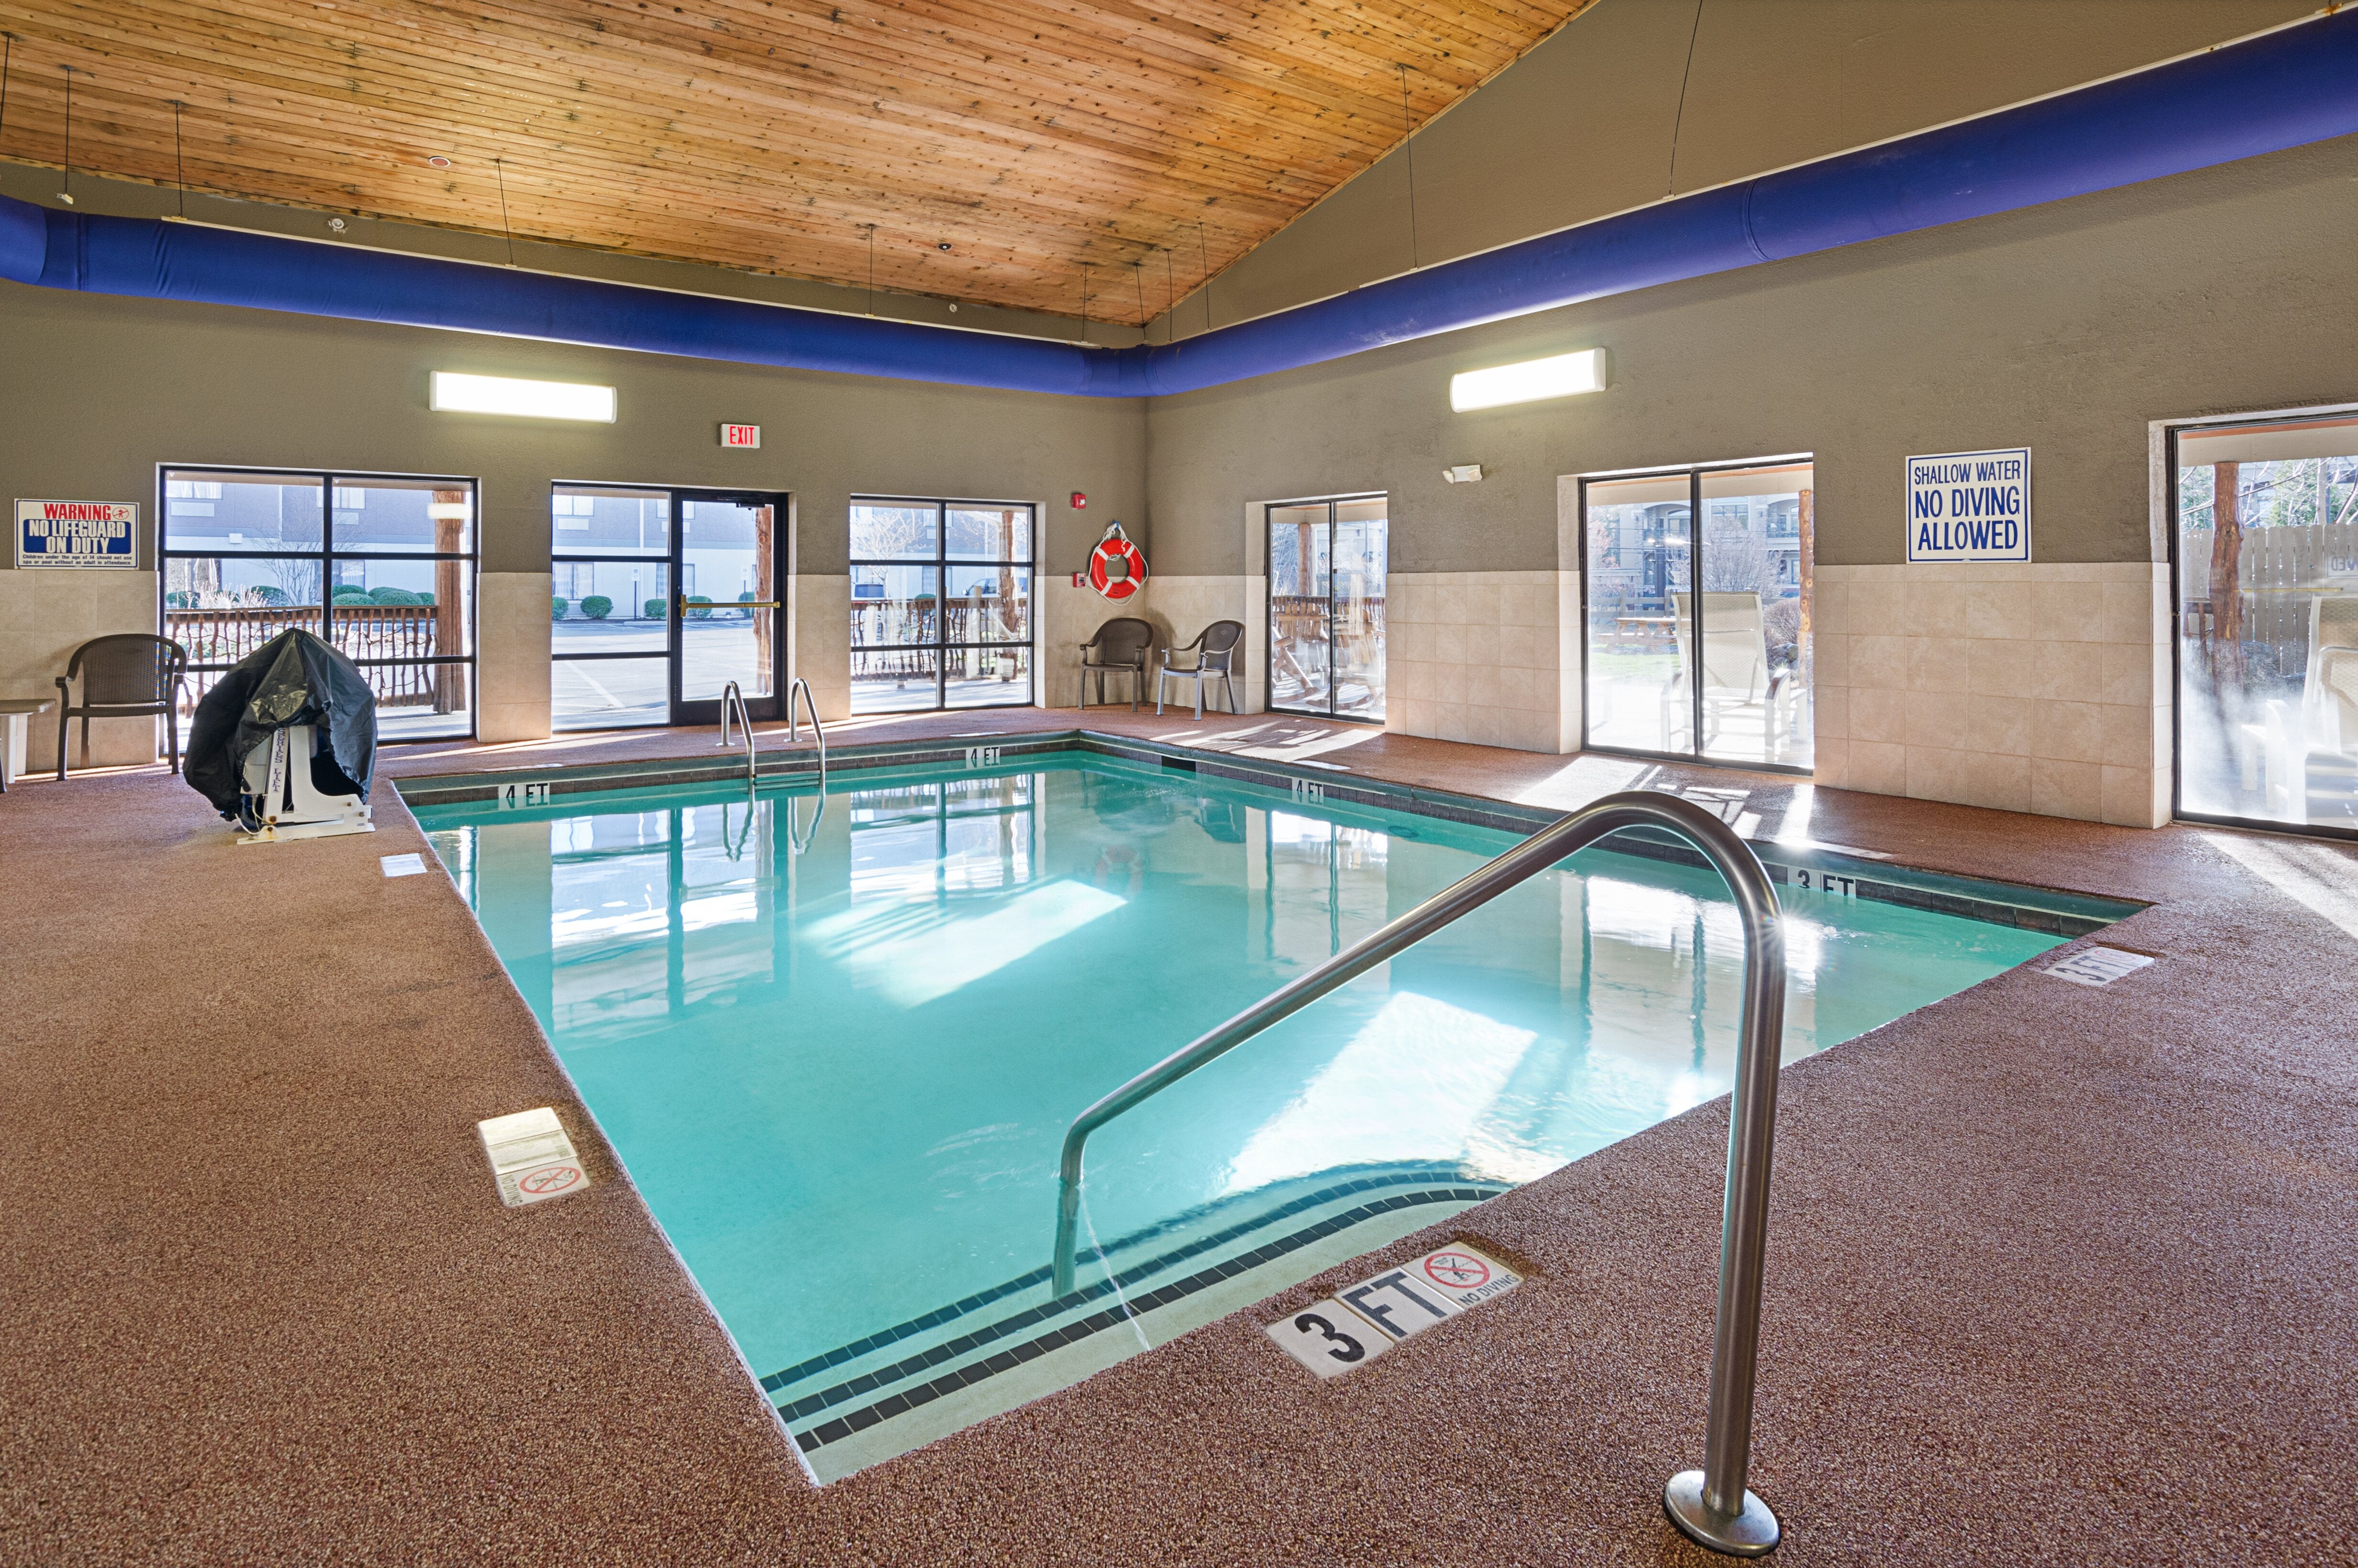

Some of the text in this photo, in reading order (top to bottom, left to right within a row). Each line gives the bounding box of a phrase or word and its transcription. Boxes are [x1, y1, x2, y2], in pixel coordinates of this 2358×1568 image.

[729, 426, 755, 445] EXIT
[1914, 460, 2020, 485] SHALLOW WATER
[44, 503, 111, 521] WARNING
[1915, 485, 2020, 519] NO DIVING
[29, 520, 126, 538] NO LIFEGUARD
[1918, 520, 2018, 550] ALLOWED
[46, 537, 110, 554] ON DUTY
[273, 728, 286, 792] SERIES LIFT
[984, 746, 999, 758] FT
[526, 783, 548, 797] FT
[1308, 781, 1323, 796] FT
[1798, 869, 1854, 897] 3 FT
[503, 1184, 523, 1206] DIVING
[1294, 1271, 1520, 1363] 3 FT NO DIVING
